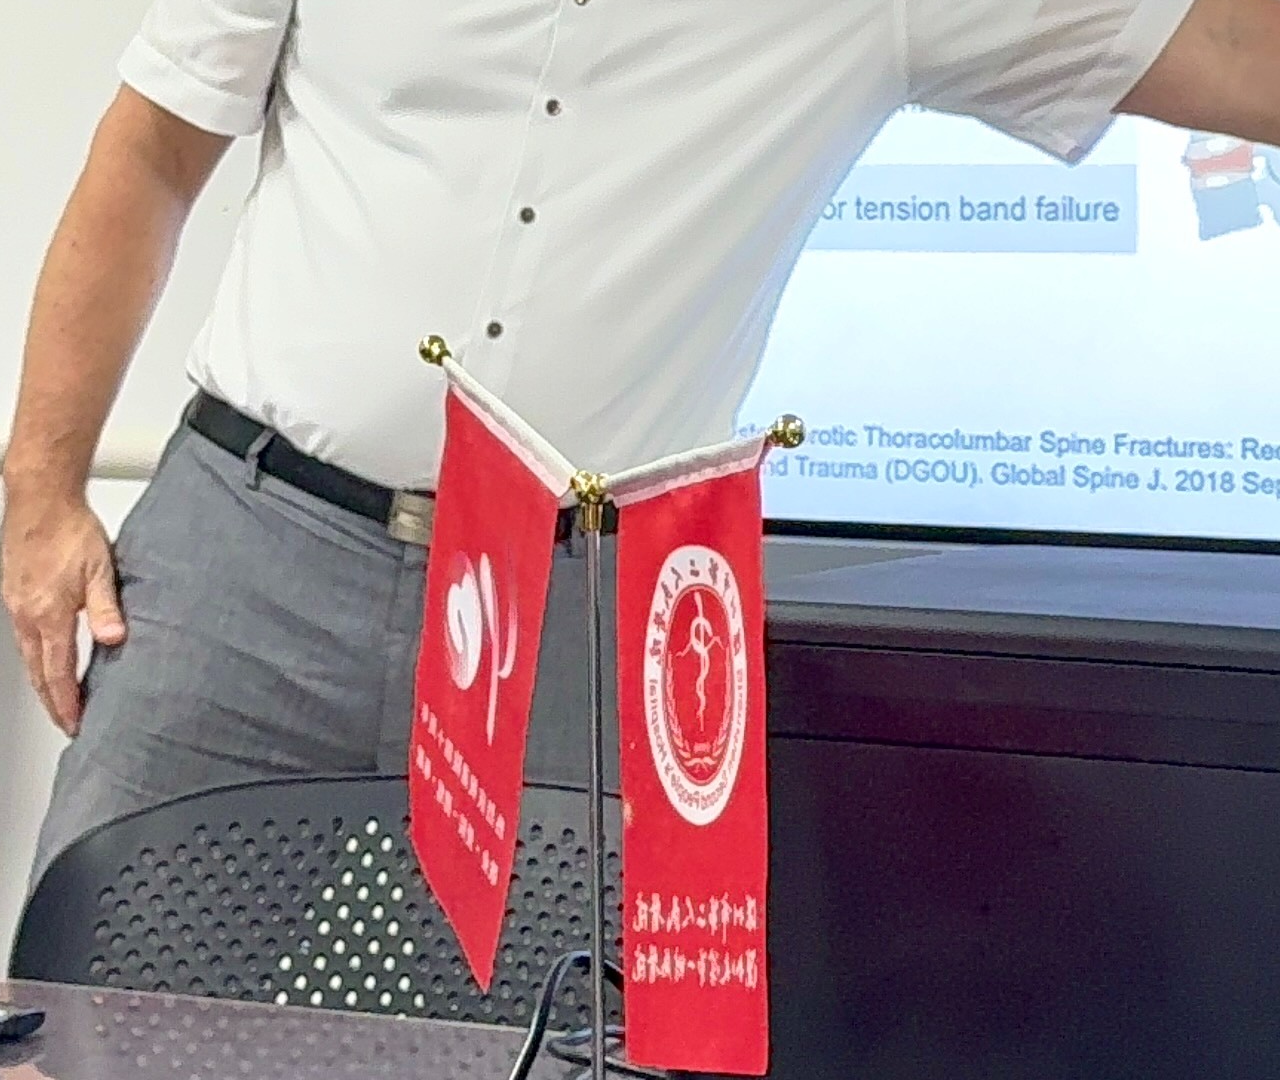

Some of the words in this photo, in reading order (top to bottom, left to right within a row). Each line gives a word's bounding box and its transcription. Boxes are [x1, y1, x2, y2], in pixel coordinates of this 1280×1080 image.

[854, 194, 951, 222] tension
[959, 195, 1026, 222] band
[1034, 195, 1120, 222] failure
[863, 425, 1033, 453] Thoracolumbar
[1039, 430, 1107, 459] Spine
[1113, 432, 1234, 460] Fractures:
[794, 454, 879, 481] Trauma
[885, 458, 984, 489] (DGOU).
[990, 461, 1066, 487] Global
[1072, 464, 1140, 494] Spine
[1174, 469, 1236, 494] 2018
